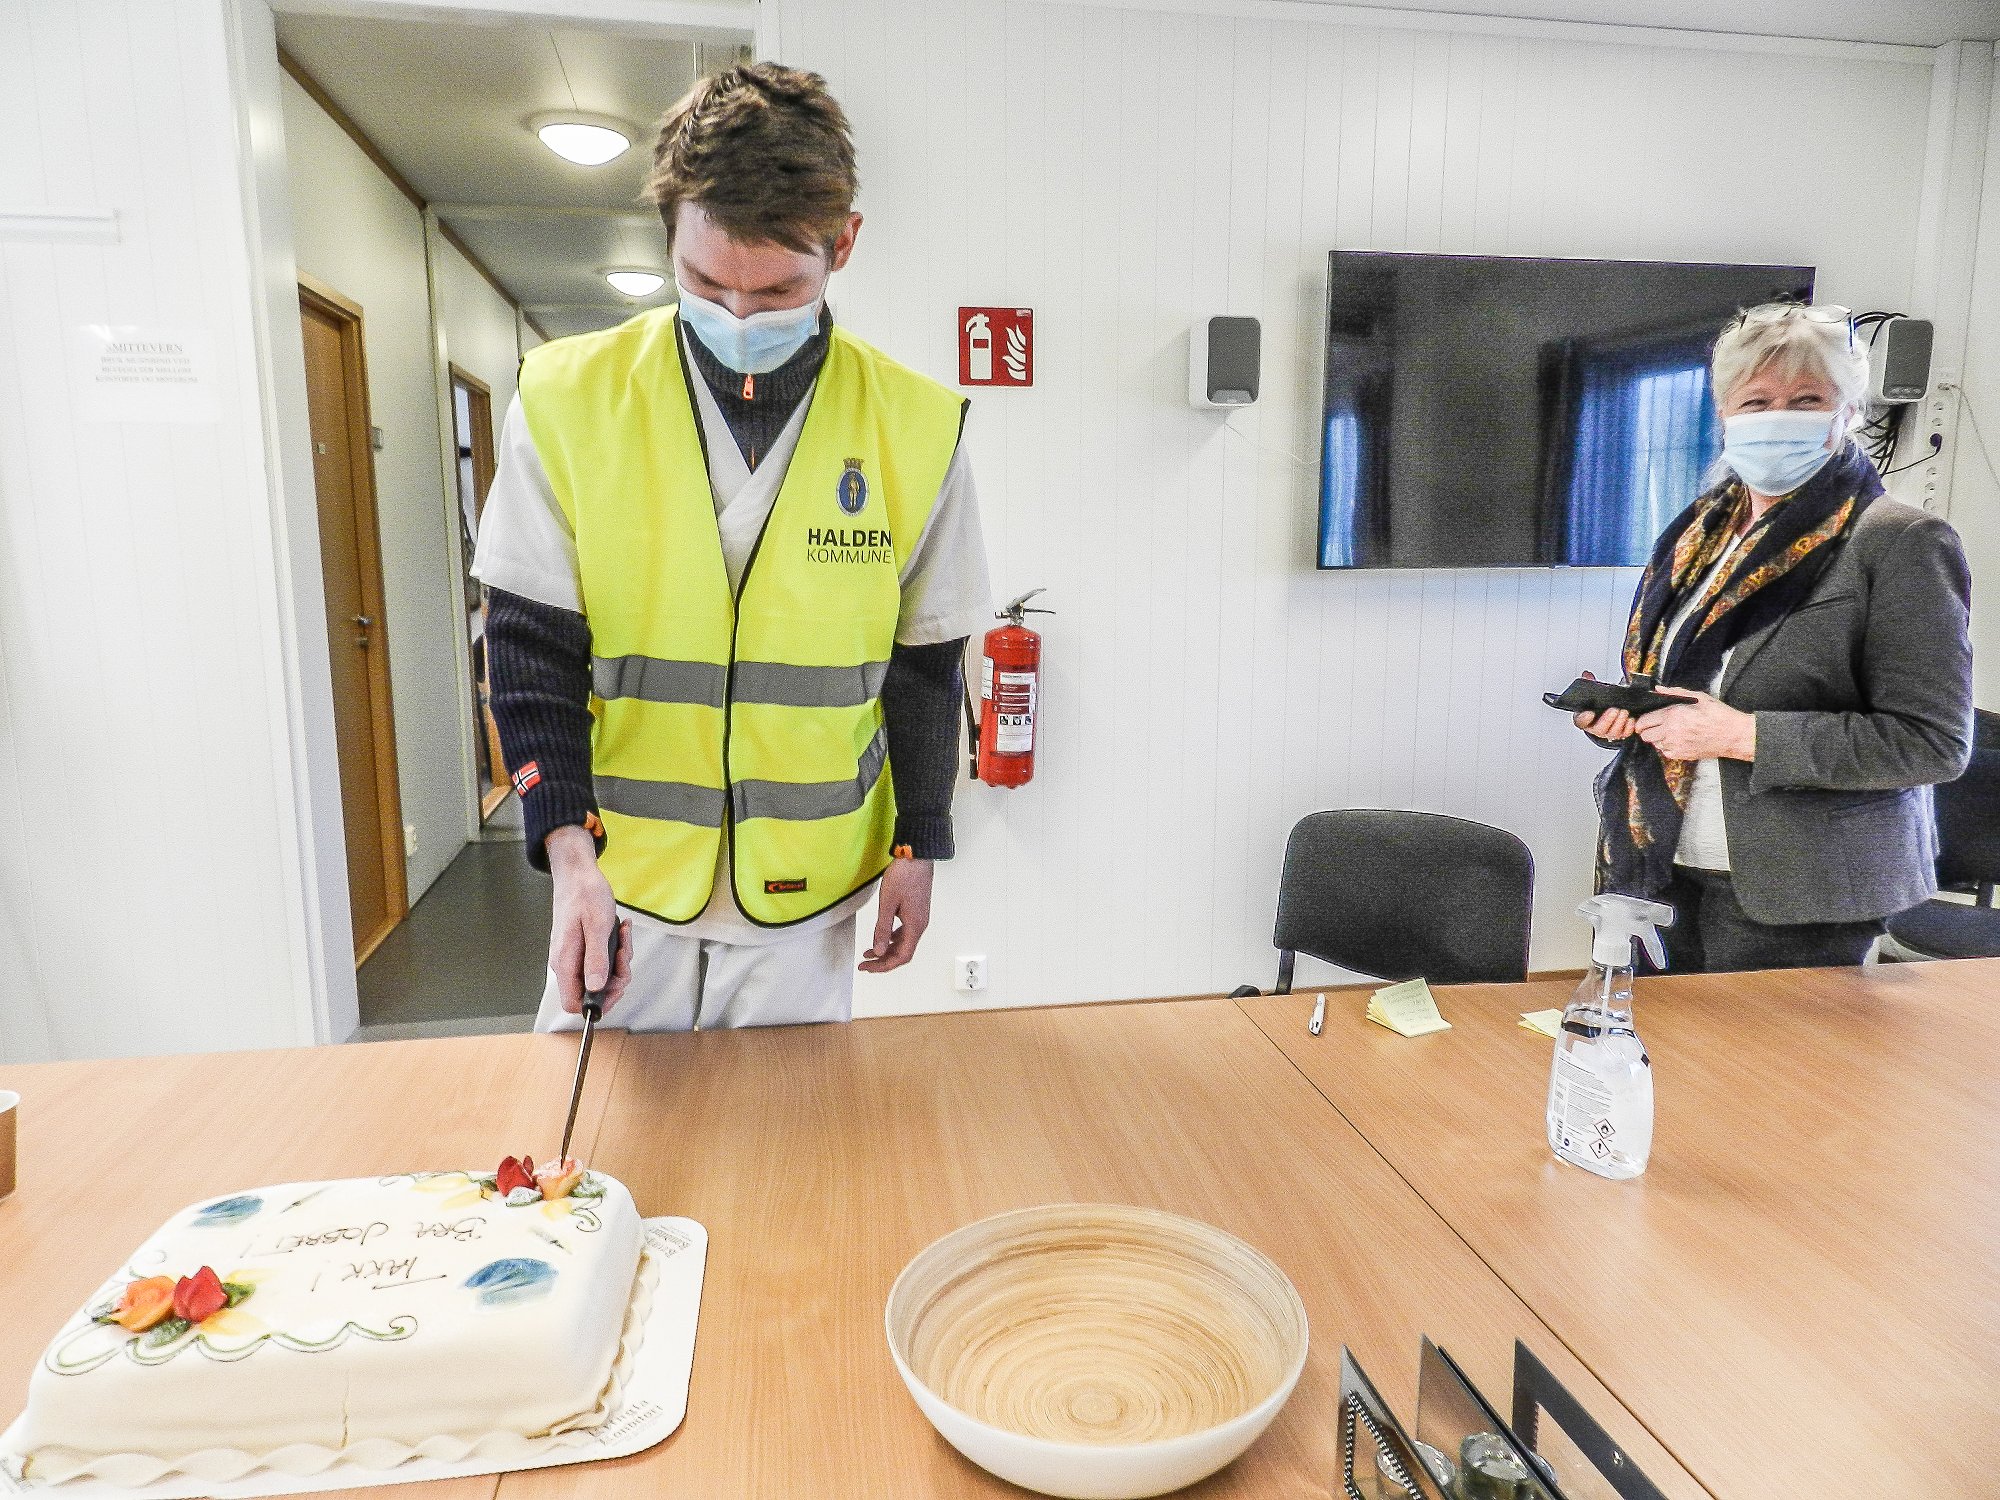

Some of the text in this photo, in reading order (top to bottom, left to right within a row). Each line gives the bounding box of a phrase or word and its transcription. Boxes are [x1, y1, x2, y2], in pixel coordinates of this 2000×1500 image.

[808, 528, 891, 547] HALDEN
[807, 548, 892, 564] KOMMUNE
[417, 1216, 487, 1242] BRA
